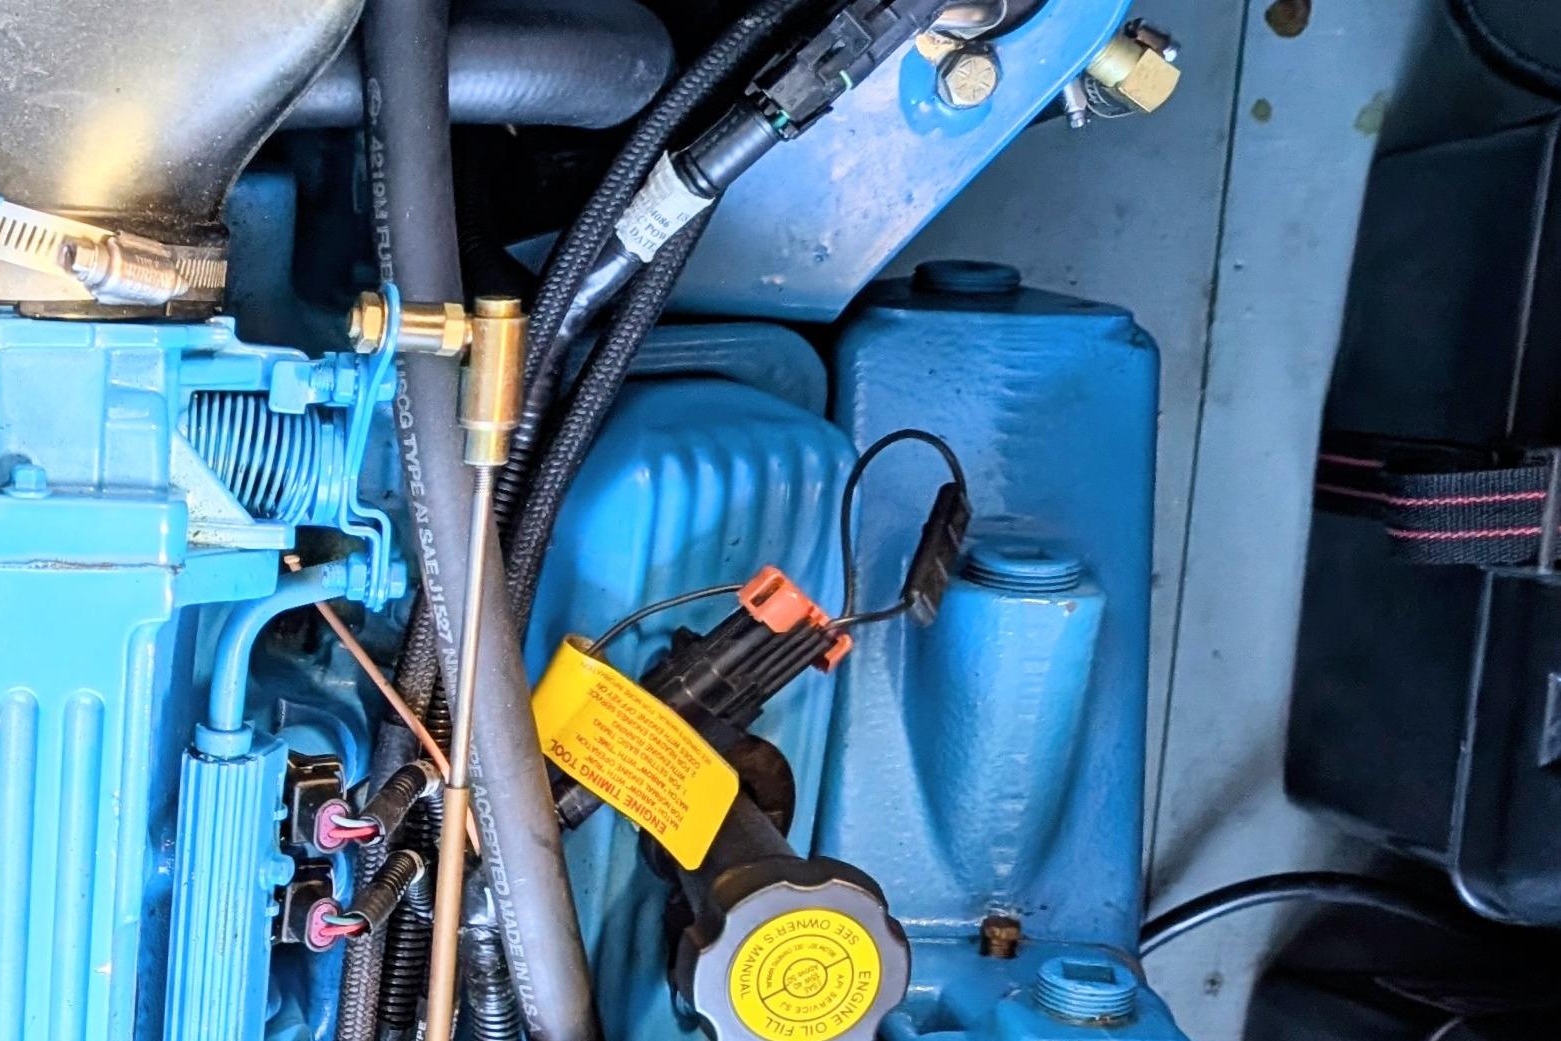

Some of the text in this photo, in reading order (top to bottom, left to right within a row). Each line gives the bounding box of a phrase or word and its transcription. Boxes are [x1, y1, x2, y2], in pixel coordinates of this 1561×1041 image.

[368, 134, 388, 220] 4219M
[375, 224, 394, 284] FUE
[401, 433, 425, 497] TYPE
[417, 527, 439, 575] SAE
[428, 578, 454, 645] J1527
[471, 781, 511, 898] ACCEPTED
[497, 896, 523, 958] MADE
[512, 959, 529, 983] IN
[578, 763, 623, 800] TIMING
[622, 794, 668, 834] ENGINE
[740, 919, 859, 999] SEE OWNER'S MANUAL
[765, 970, 870, 1036] ENGINE OIL FILL
[779, 974, 843, 1013] API SERVICE SJ
